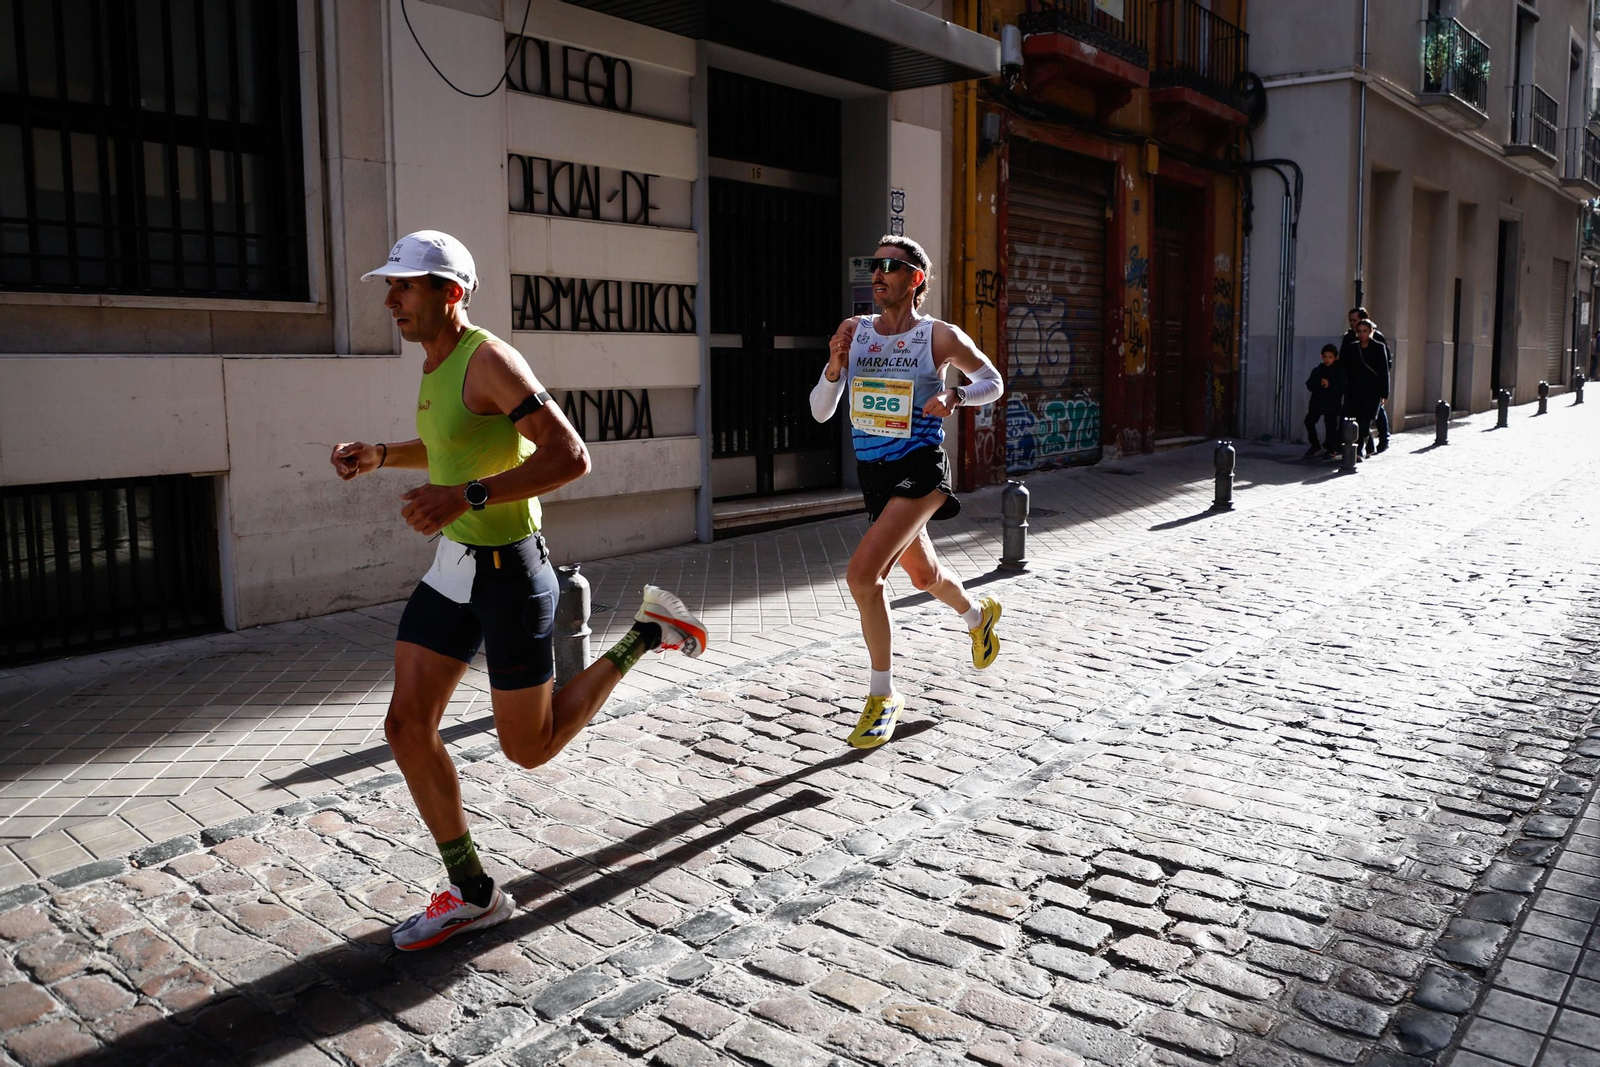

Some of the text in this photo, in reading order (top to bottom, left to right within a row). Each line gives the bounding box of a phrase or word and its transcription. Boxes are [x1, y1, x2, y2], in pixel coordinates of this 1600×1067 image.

[506, 34, 632, 113] COLEGIO
[751, 167, 762, 180] 16
[856, 357, 919, 368] MARACENA
[862, 394, 900, 412] 926
[609, 630, 641, 658] VOLBE
